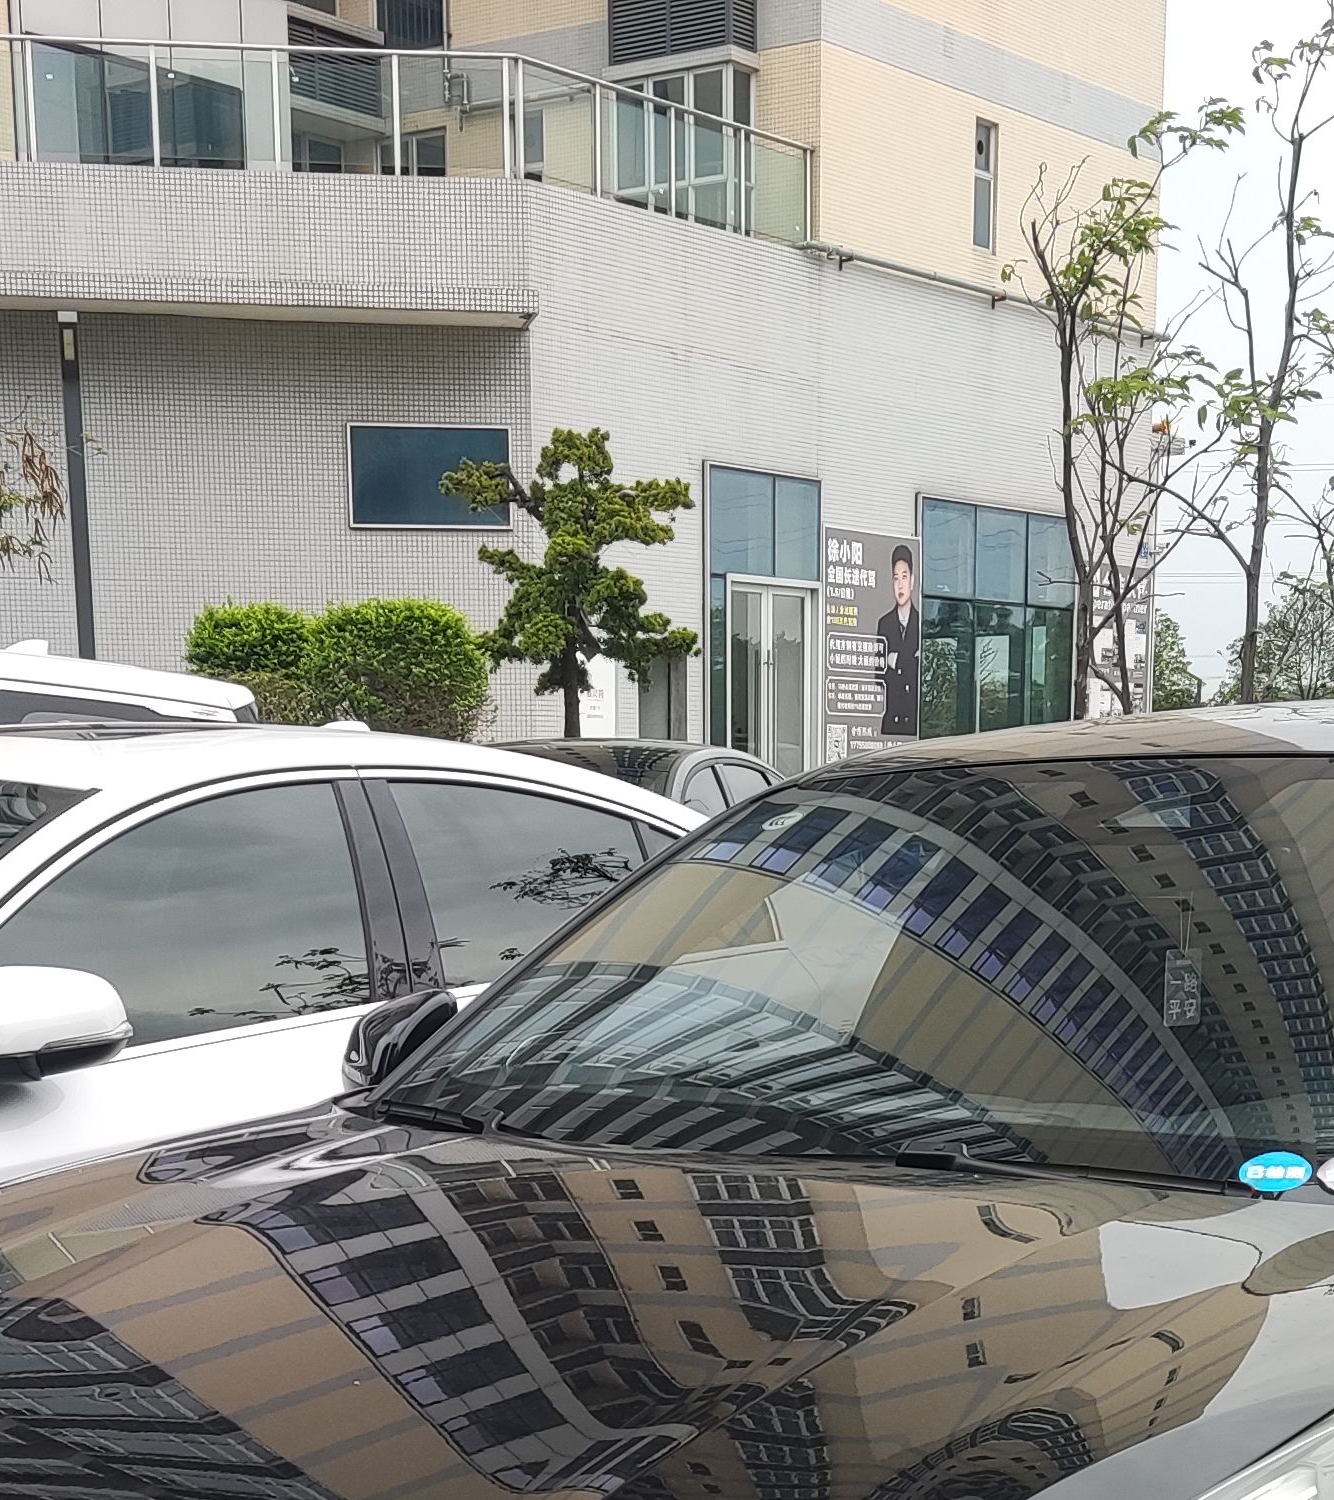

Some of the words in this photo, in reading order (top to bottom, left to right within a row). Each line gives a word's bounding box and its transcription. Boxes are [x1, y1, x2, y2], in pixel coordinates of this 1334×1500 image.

[827, 537, 863, 566] 徐小阳
[1168, 998, 1197, 1019] 平安
